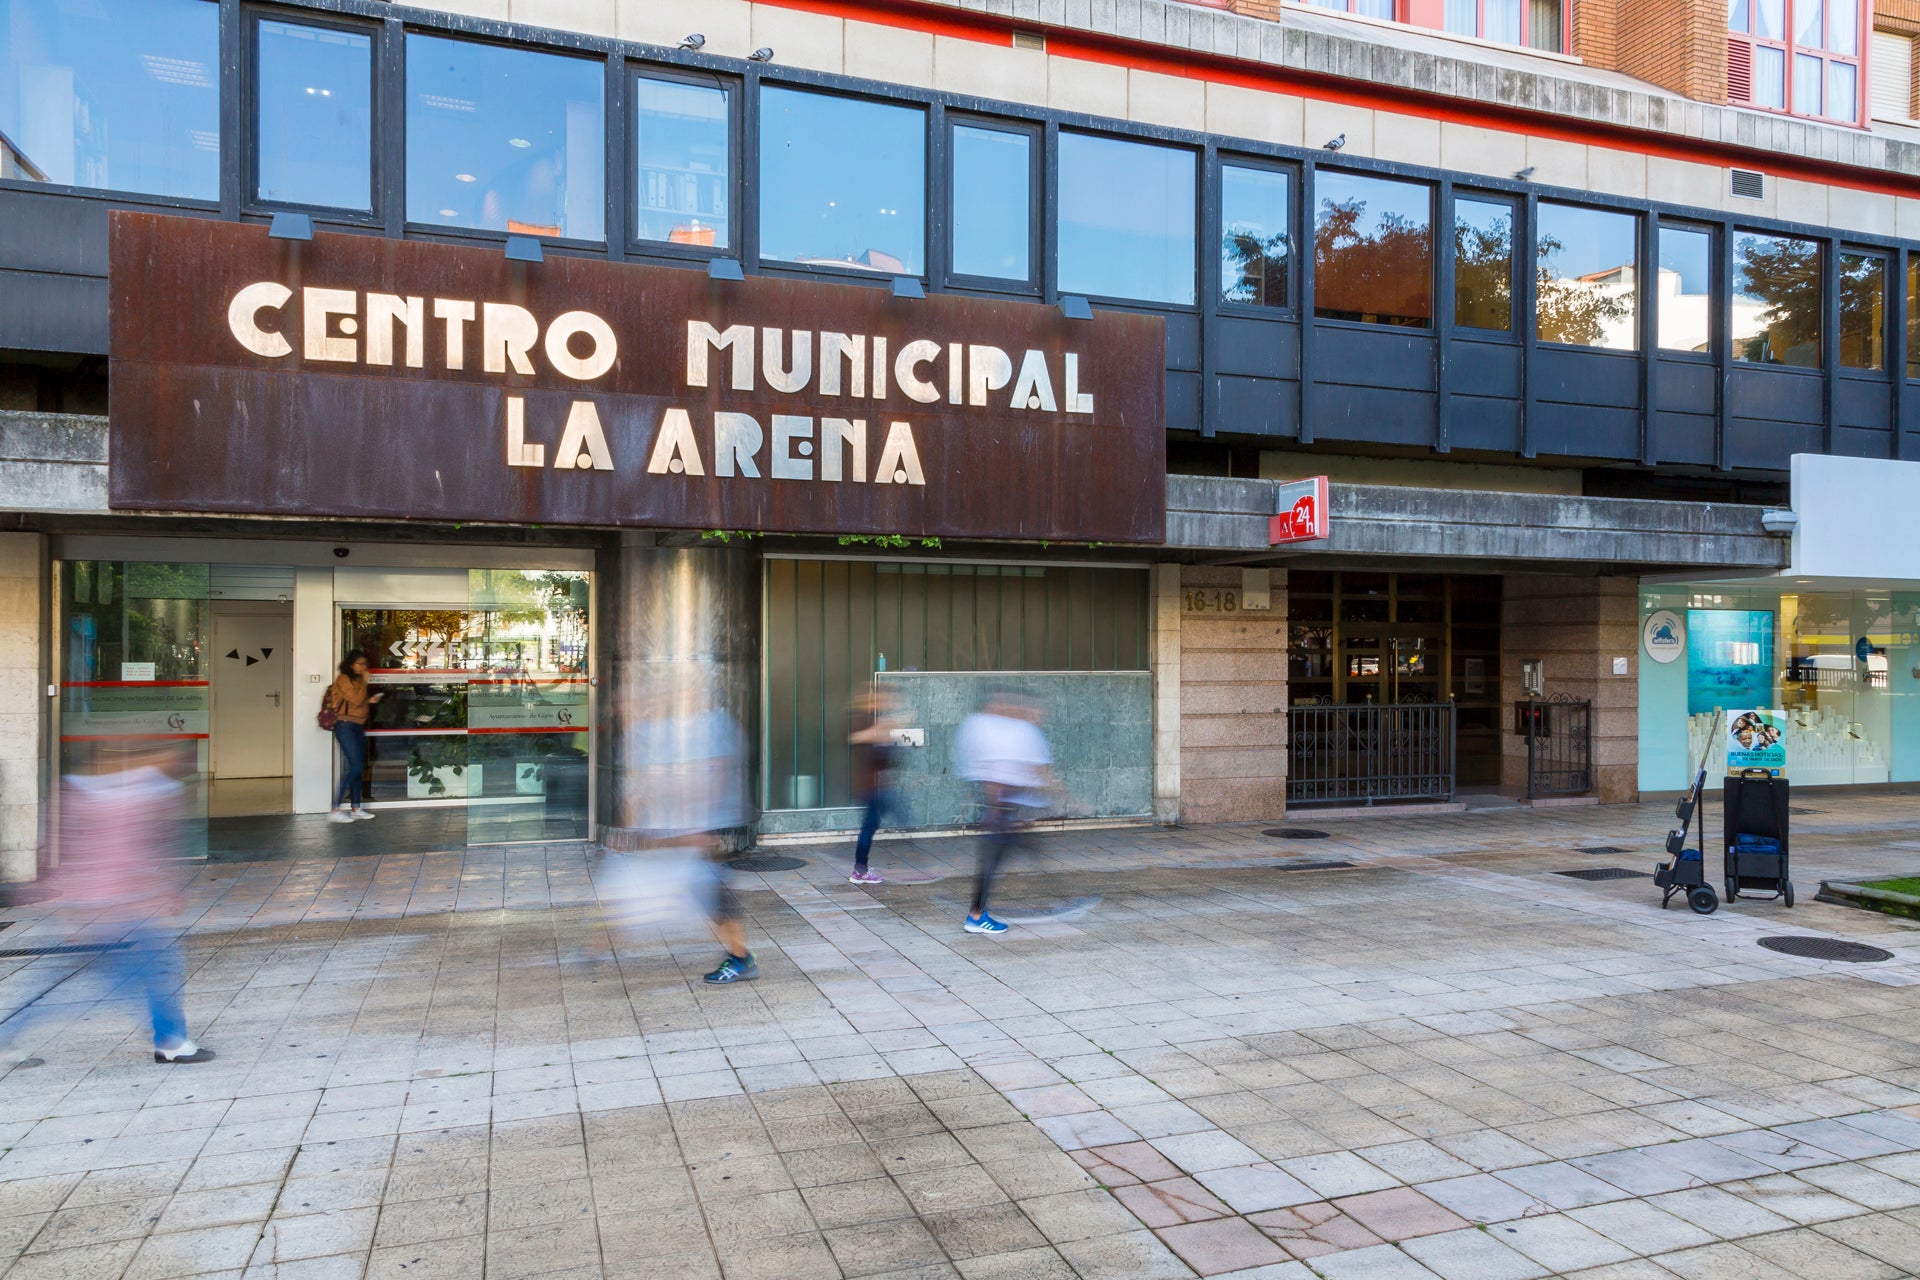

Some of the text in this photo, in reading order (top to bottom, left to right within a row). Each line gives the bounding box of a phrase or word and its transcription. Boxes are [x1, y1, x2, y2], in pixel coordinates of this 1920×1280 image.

[227, 281, 1094, 414] CENTRO MUNICIPAL
[507, 396, 926, 486] LA ARENA
[1296, 505, 1310, 523] 24
[1185, 591, 1237, 612] 16-18
